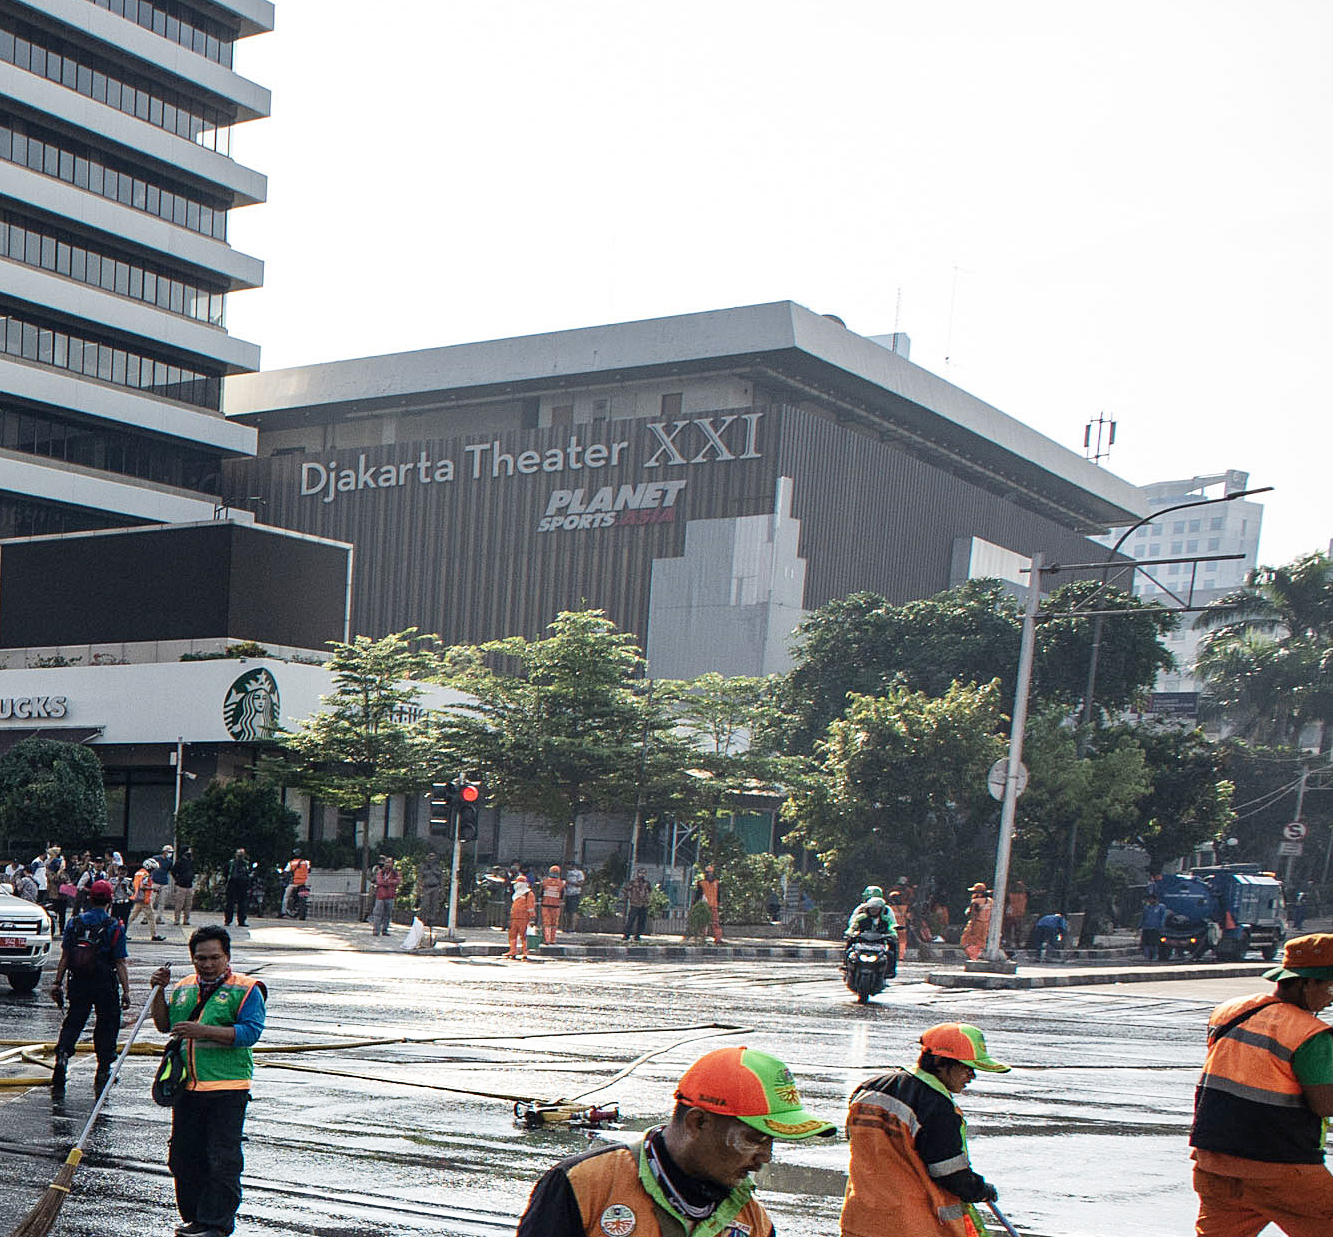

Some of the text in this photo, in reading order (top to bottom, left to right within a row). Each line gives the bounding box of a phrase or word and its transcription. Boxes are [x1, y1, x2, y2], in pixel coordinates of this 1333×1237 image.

[300, 413, 765, 503] Djakarta Theater XXI
[544, 480, 687, 516] PLANET
[537, 511, 618, 533] SPORTS
